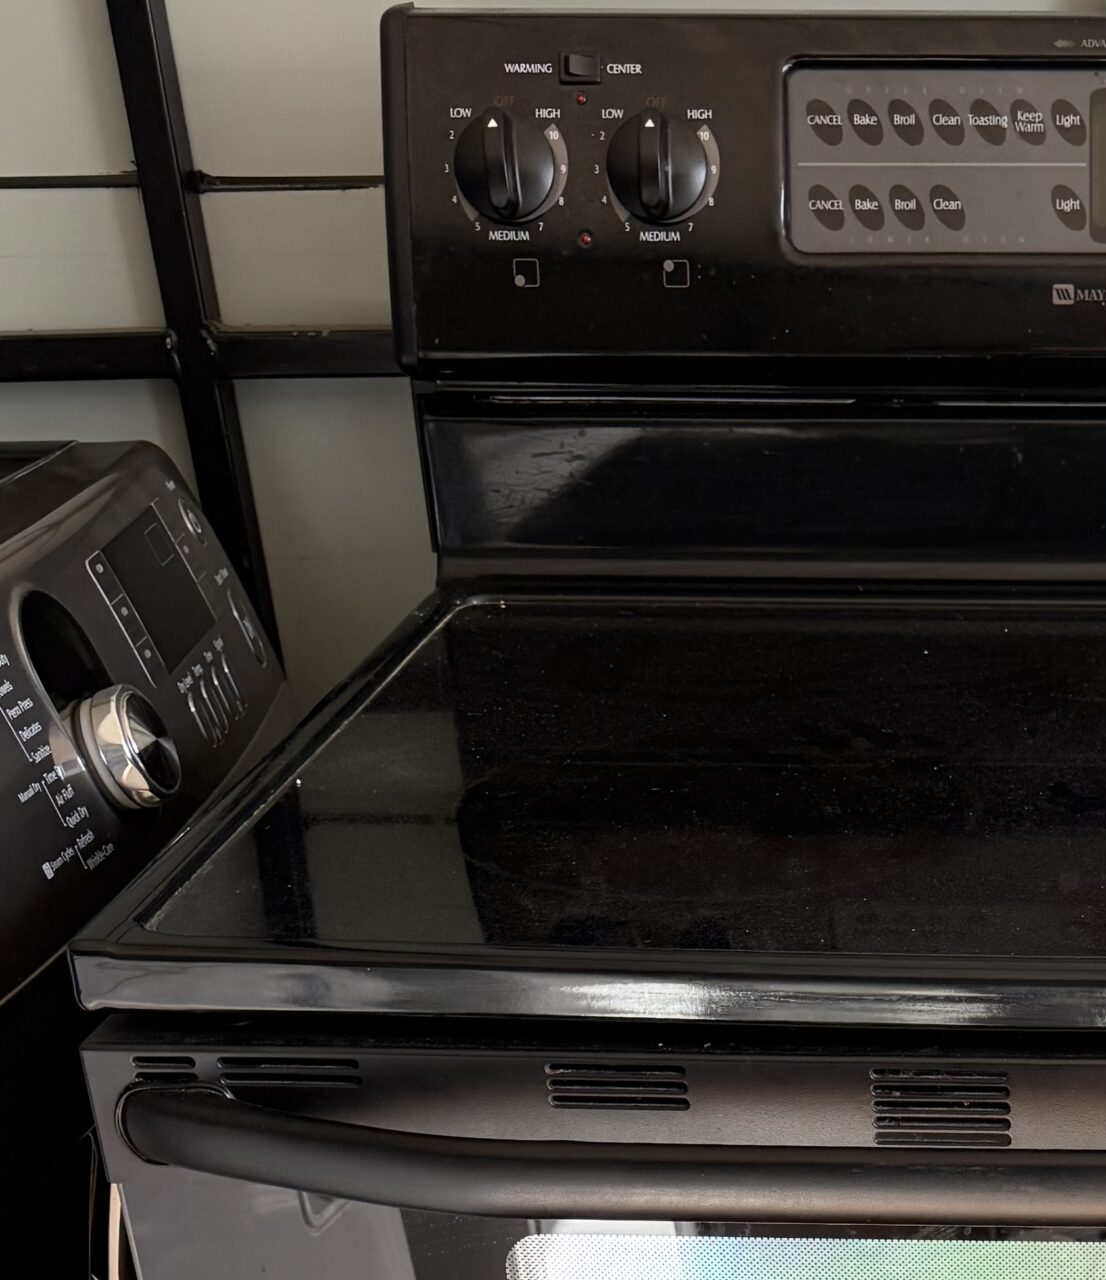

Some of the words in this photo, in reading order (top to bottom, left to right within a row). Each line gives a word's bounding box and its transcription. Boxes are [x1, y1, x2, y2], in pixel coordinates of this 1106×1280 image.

[504, 63, 553, 74] WARMING
[606, 63, 643, 74] CENTER
[450, 108, 472, 118] LOW
[535, 108, 561, 118] HIGH
[601, 108, 624, 119] LOW
[687, 109, 713, 119] HIGH
[1017, 110, 1043, 123] Keep
[807, 114, 842, 126] CANCEL
[853, 114, 878, 126] Bake
[893, 114, 916, 126] Broil
[932, 114, 961, 126] Clean
[967, 114, 1008, 128] Toasting
[1056, 114, 1080, 127] Light
[1015, 122, 1044, 133] Warm
[549, 131, 559, 140] 10
[700, 131, 709, 141] 10
[809, 199, 844, 211] CANCEL
[854, 199, 879, 211] Bake
[894, 199, 917, 211] Broil
[933, 199, 961, 211] Clean
[1056, 199, 1080, 212] Light
[489, 231, 530, 241] MEDIUM
[639, 231, 681, 242] MEDIUM
[19, 721, 43, 742] Delicates
[42, 770, 59, 785] Time
